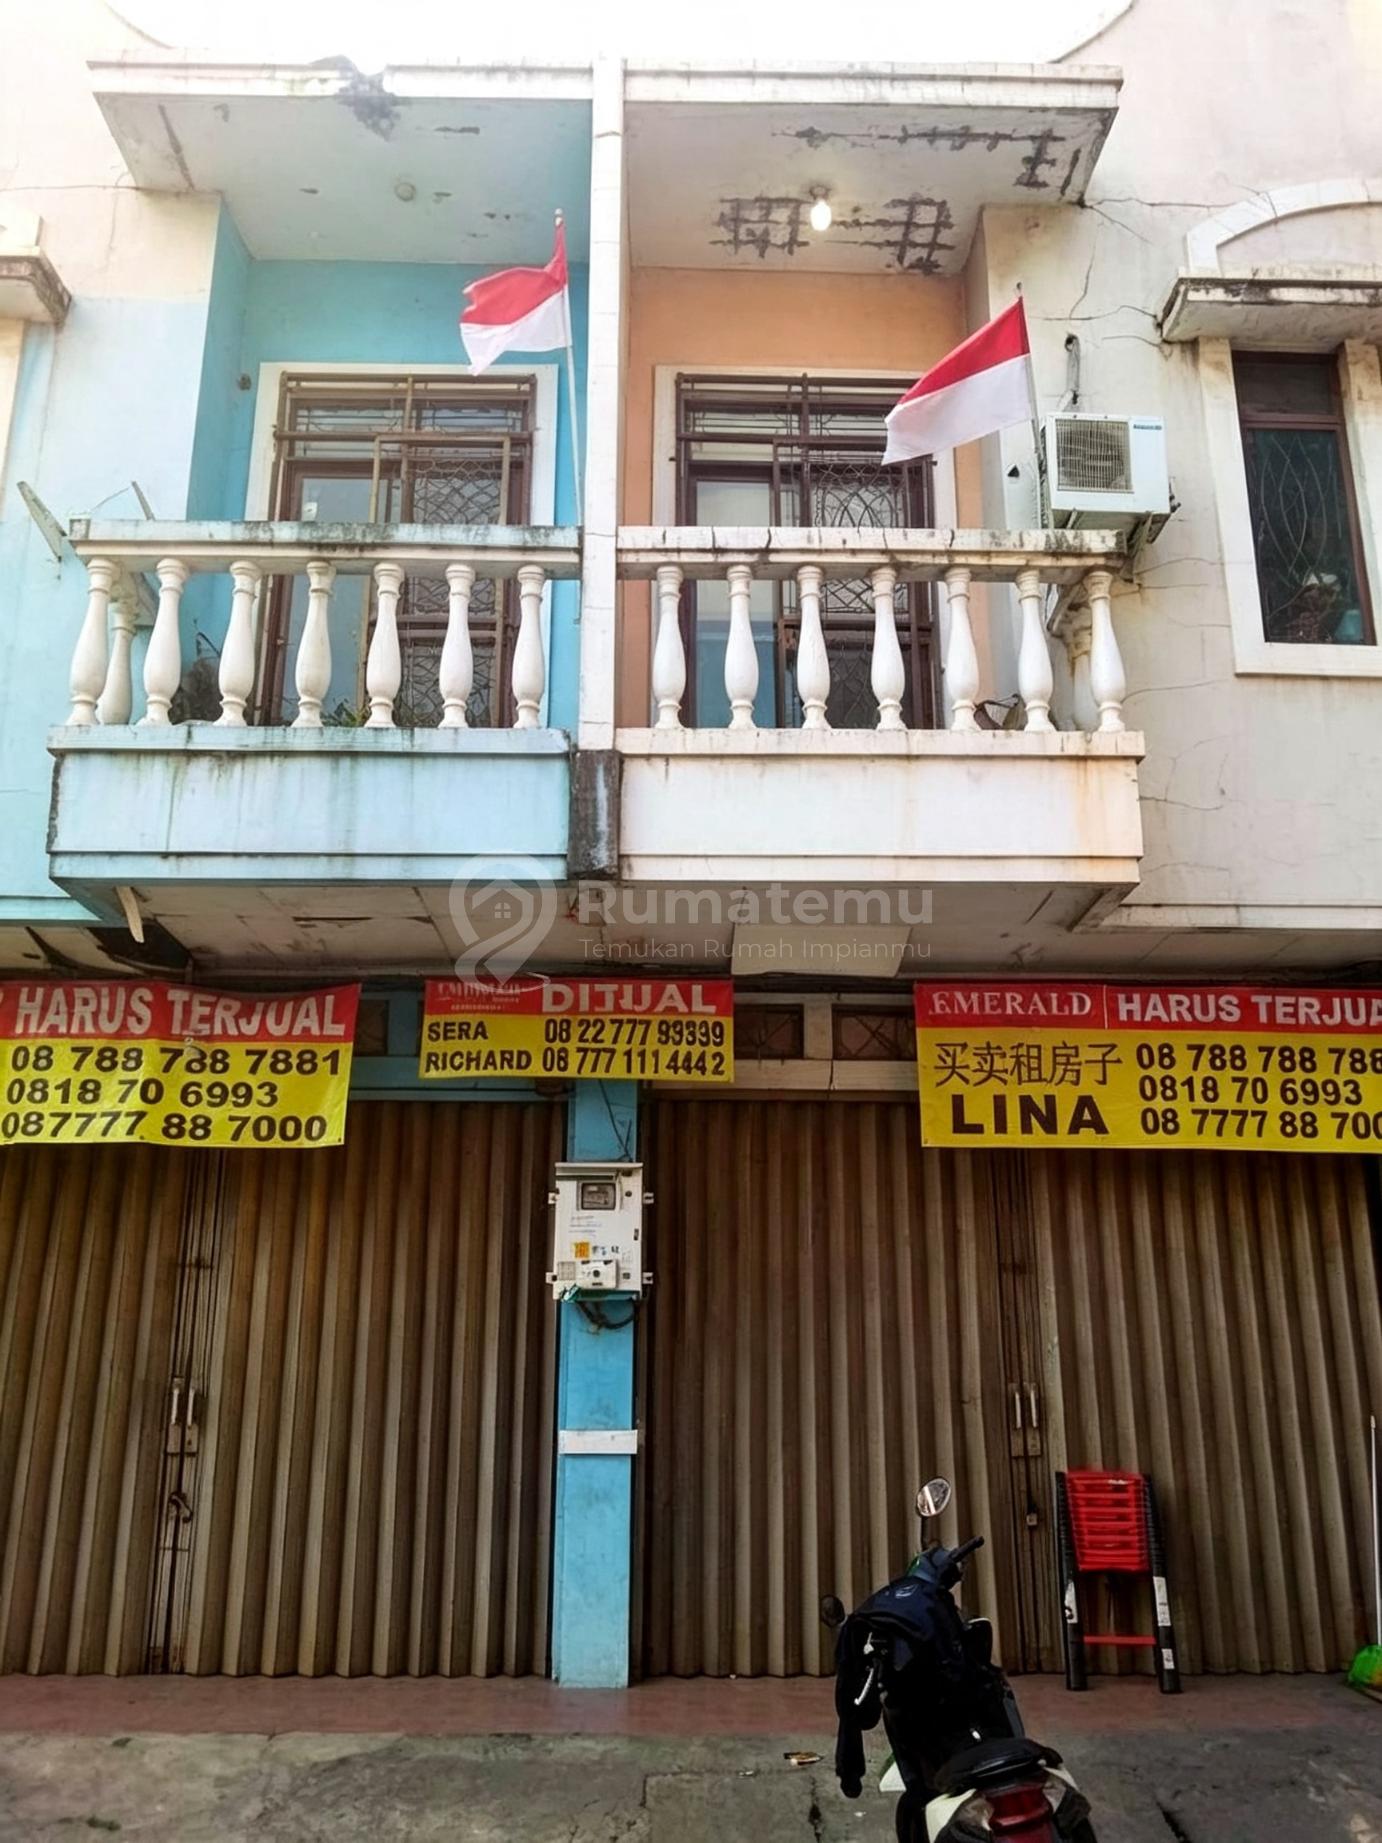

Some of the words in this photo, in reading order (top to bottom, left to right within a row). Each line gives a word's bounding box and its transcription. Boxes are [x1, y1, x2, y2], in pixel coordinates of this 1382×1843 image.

[15, 986, 153, 1035] HARUS
[166, 989, 346, 1037] TERJUAL
[928, 991, 1092, 1016] EMERALD
[1117, 993, 1242, 1023] HARUS
[427, 1020, 489, 1042] SERA
[11, 1045, 54, 1072] 08
[70, 1046, 143, 1073] 788
[245, 1049, 341, 1076] 7881
[425, 1050, 532, 1073] RICHARD
[934, 1041, 1123, 1087] 买卖租房子
[1136, 1042, 1176, 1070] 08
[1186, 1043, 1247, 1072] 788
[1257, 1045, 1317, 1073] 788
[6, 1078, 101, 1105] 0818
[117, 1078, 164, 1105] 70
[179, 1081, 279, 1107] 6993
[1139, 1074, 1220, 1103] 0818
[1231, 1076, 1268, 1104] 70
[1280, 1078, 1362, 1106] 6993
[161, 1112, 213, 1140] 88
[228, 1115, 327, 1142] 7000
[951, 1094, 1110, 1135] LINA
[1279, 1111, 1318, 1139] 88
